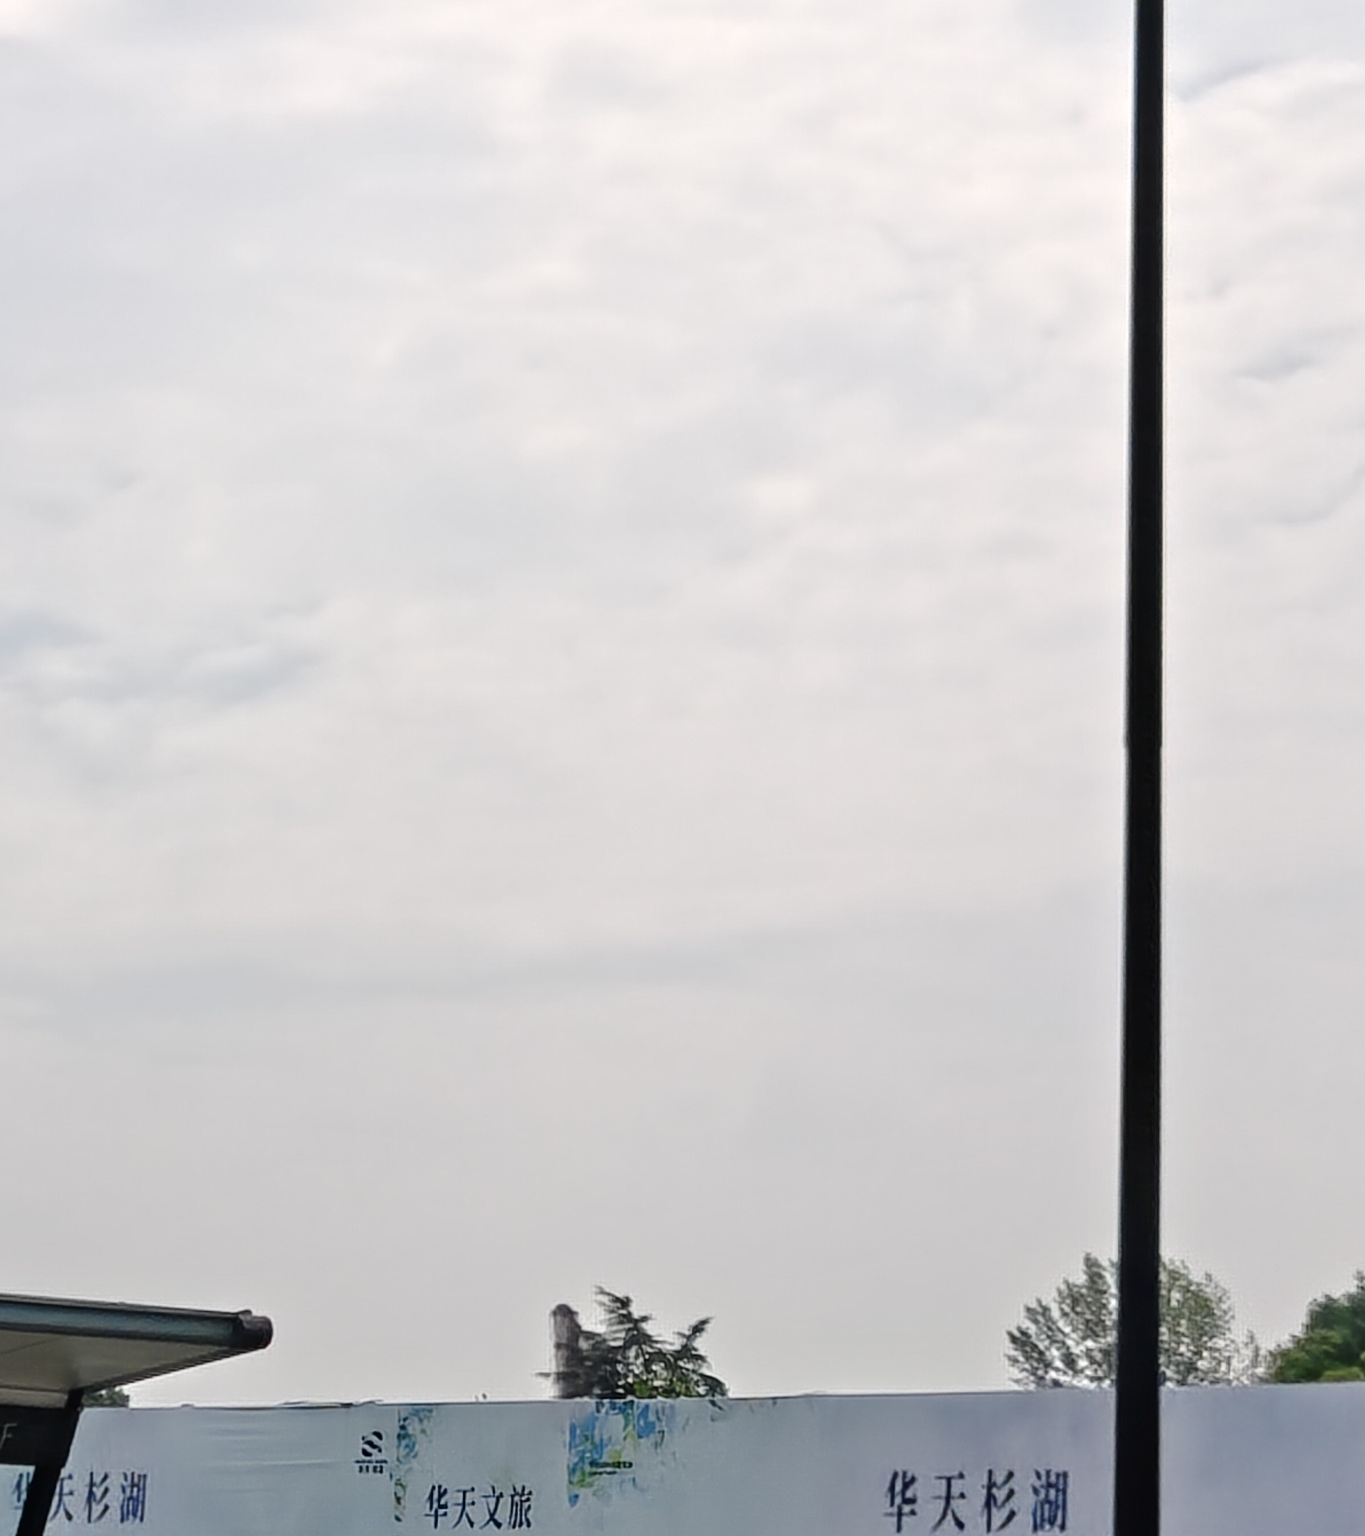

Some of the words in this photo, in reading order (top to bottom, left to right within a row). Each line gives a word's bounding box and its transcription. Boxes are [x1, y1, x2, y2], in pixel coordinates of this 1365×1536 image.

[424, 1484, 535, 1531] 华天文旅
[883, 1469, 1070, 1535] 华天杉湖
